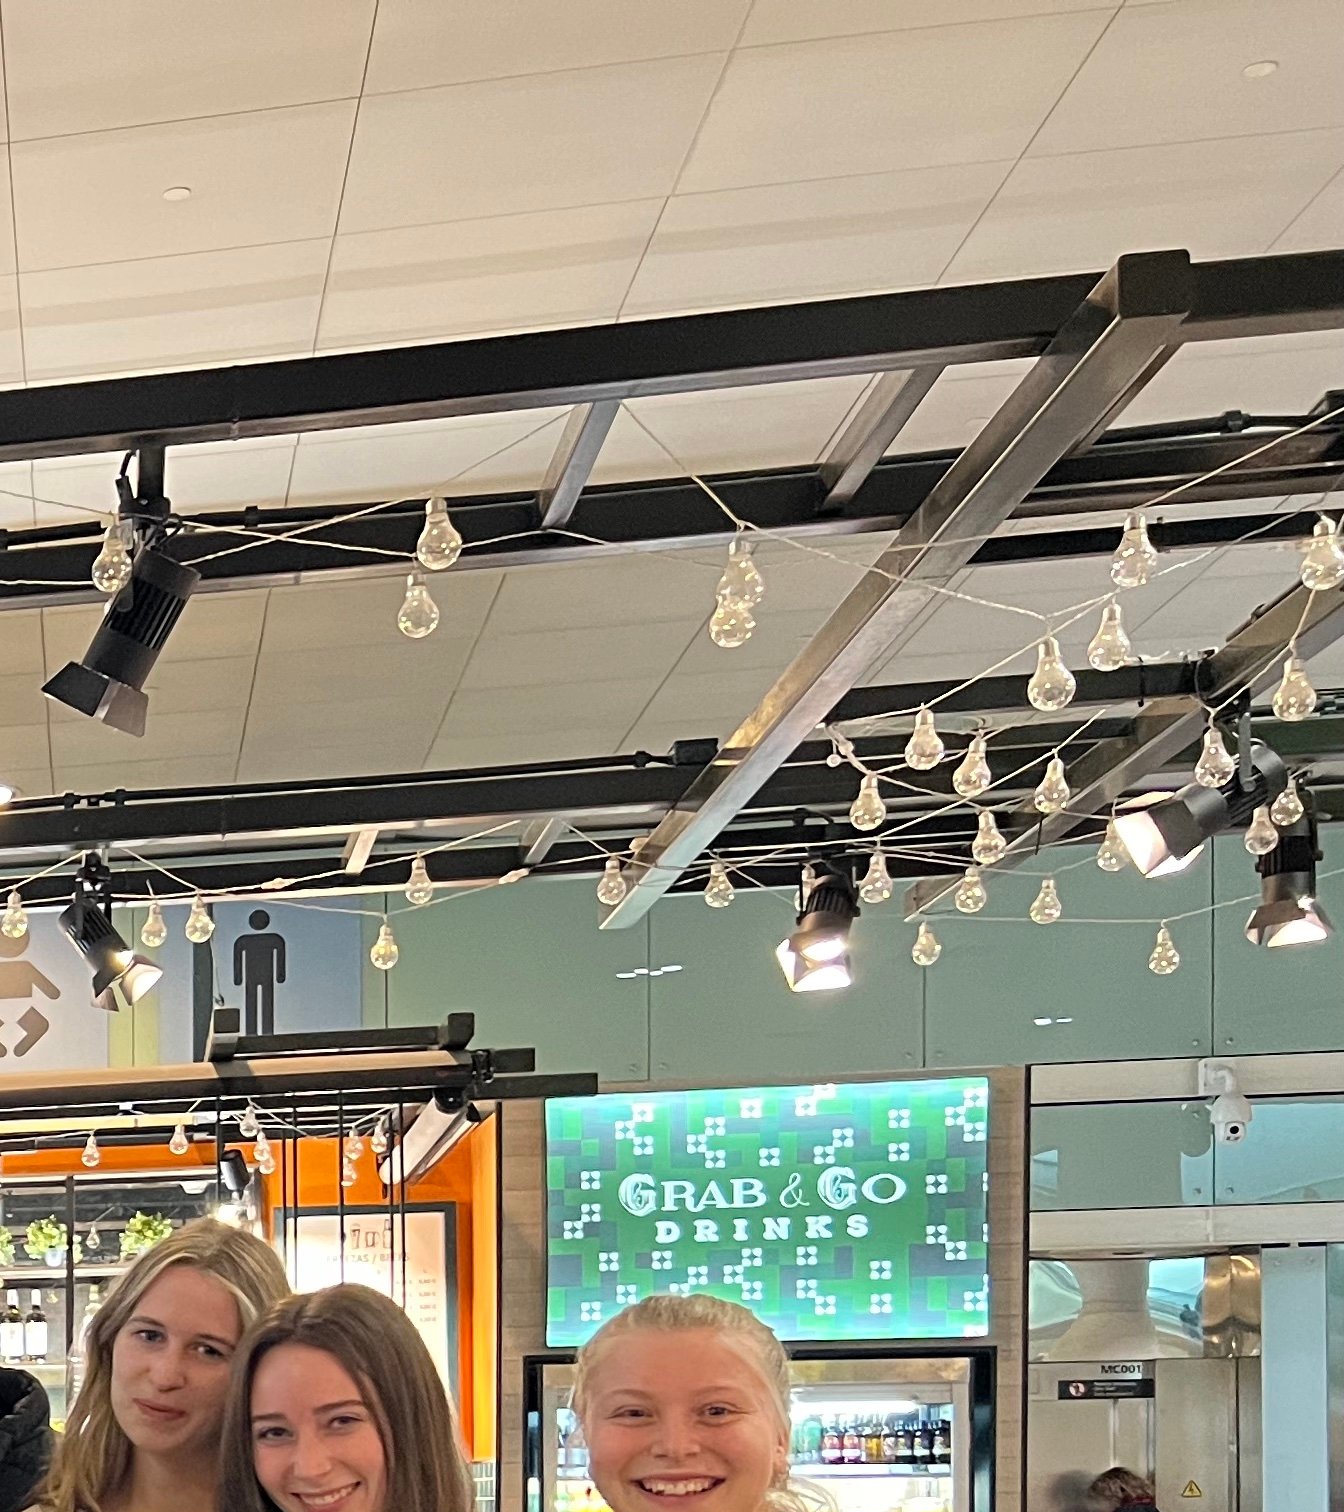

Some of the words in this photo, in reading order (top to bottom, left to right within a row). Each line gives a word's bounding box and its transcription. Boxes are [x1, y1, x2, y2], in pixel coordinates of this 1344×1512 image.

[778, 1171, 811, 1210] &
[654, 1213, 870, 1245] DRINKS
[1100, 1364, 1142, 1375] MC001
